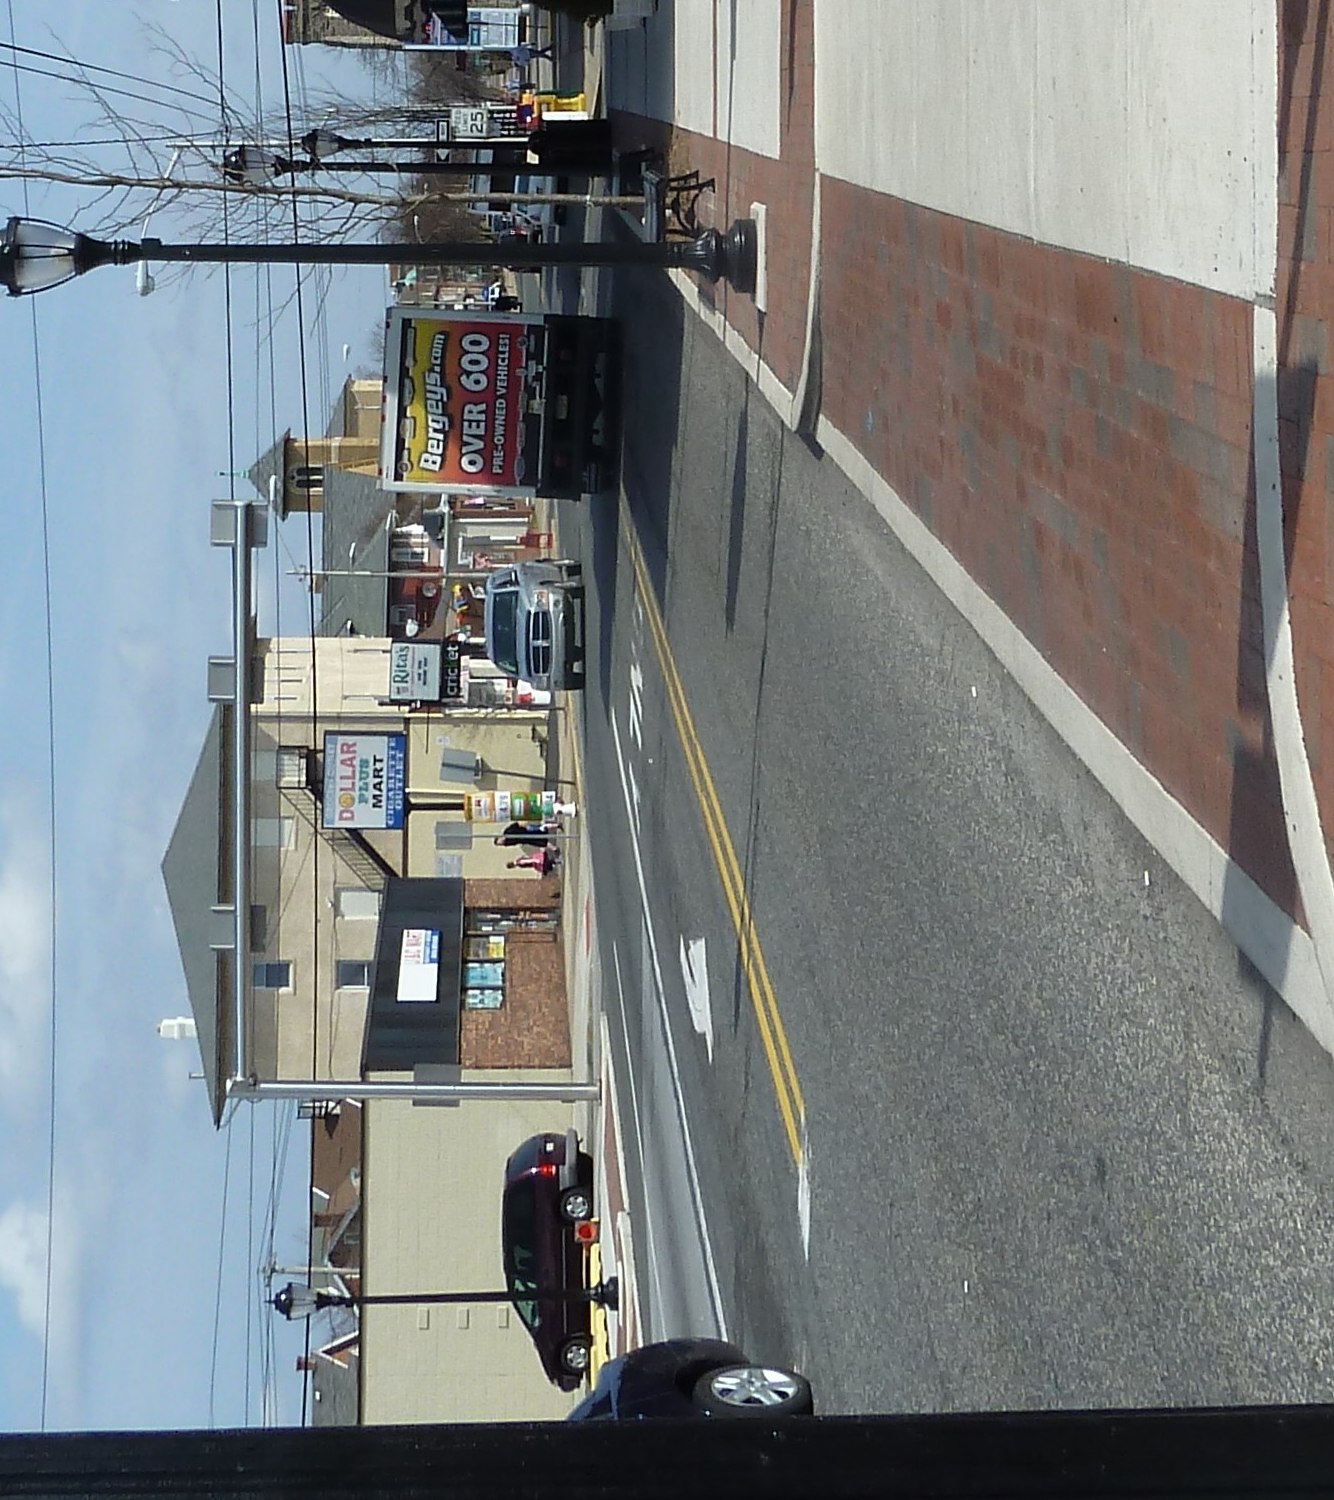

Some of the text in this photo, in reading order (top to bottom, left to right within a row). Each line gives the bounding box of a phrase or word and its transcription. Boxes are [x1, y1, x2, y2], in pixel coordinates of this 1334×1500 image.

[453, 110, 462, 135] SPEED
[470, 112, 484, 133] 25
[419, 334, 449, 471] Bergeys.com
[460, 334, 490, 473] OVER 600
[493, 334, 510, 474] PRE-OWNED VEHICLES!
[393, 646, 409, 684] Rita's
[338, 742, 356, 821] DOLLAR
[359, 758, 369, 804] PLUS
[372, 754, 383, 808] MART
[387, 738, 395, 825] CIGARETTE
[395, 750, 403, 810] OUTLET
